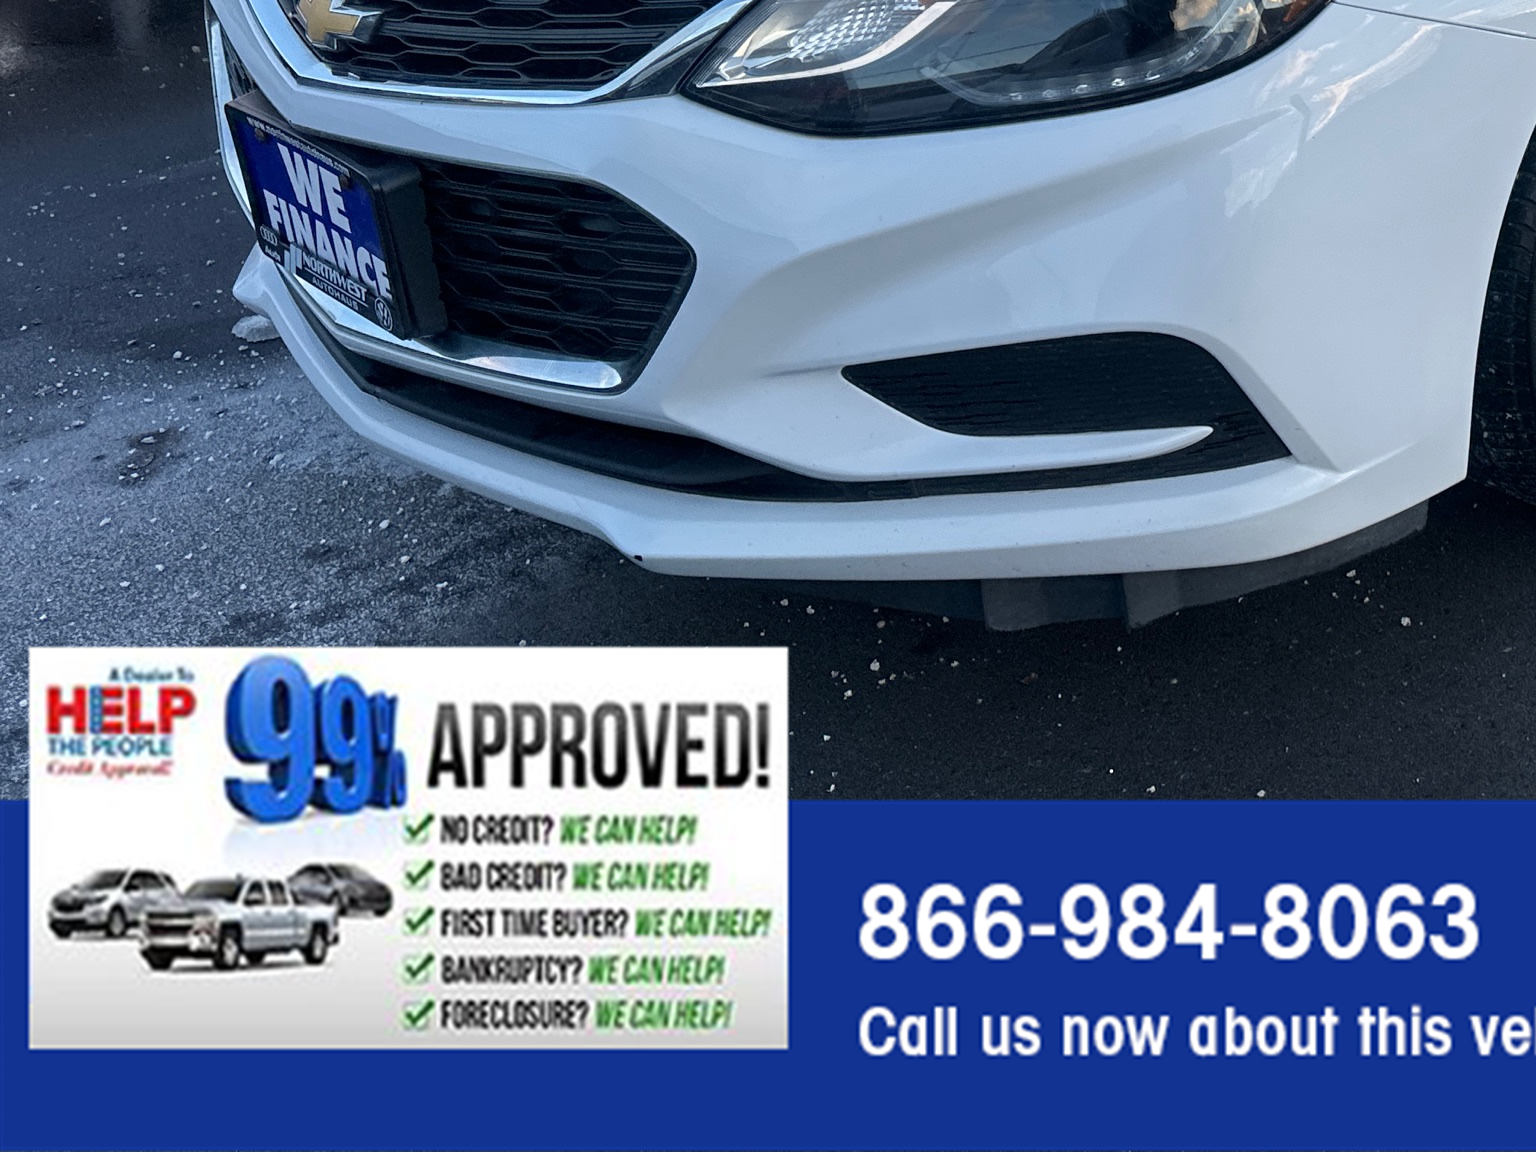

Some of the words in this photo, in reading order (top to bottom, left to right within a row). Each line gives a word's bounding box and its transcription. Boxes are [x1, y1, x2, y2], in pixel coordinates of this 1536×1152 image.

[277, 142, 352, 234] WE
[263, 188, 393, 299] FINANCE
[303, 252, 368, 302] NORTHWEST
[311, 277, 360, 311] AUTOHAUS
